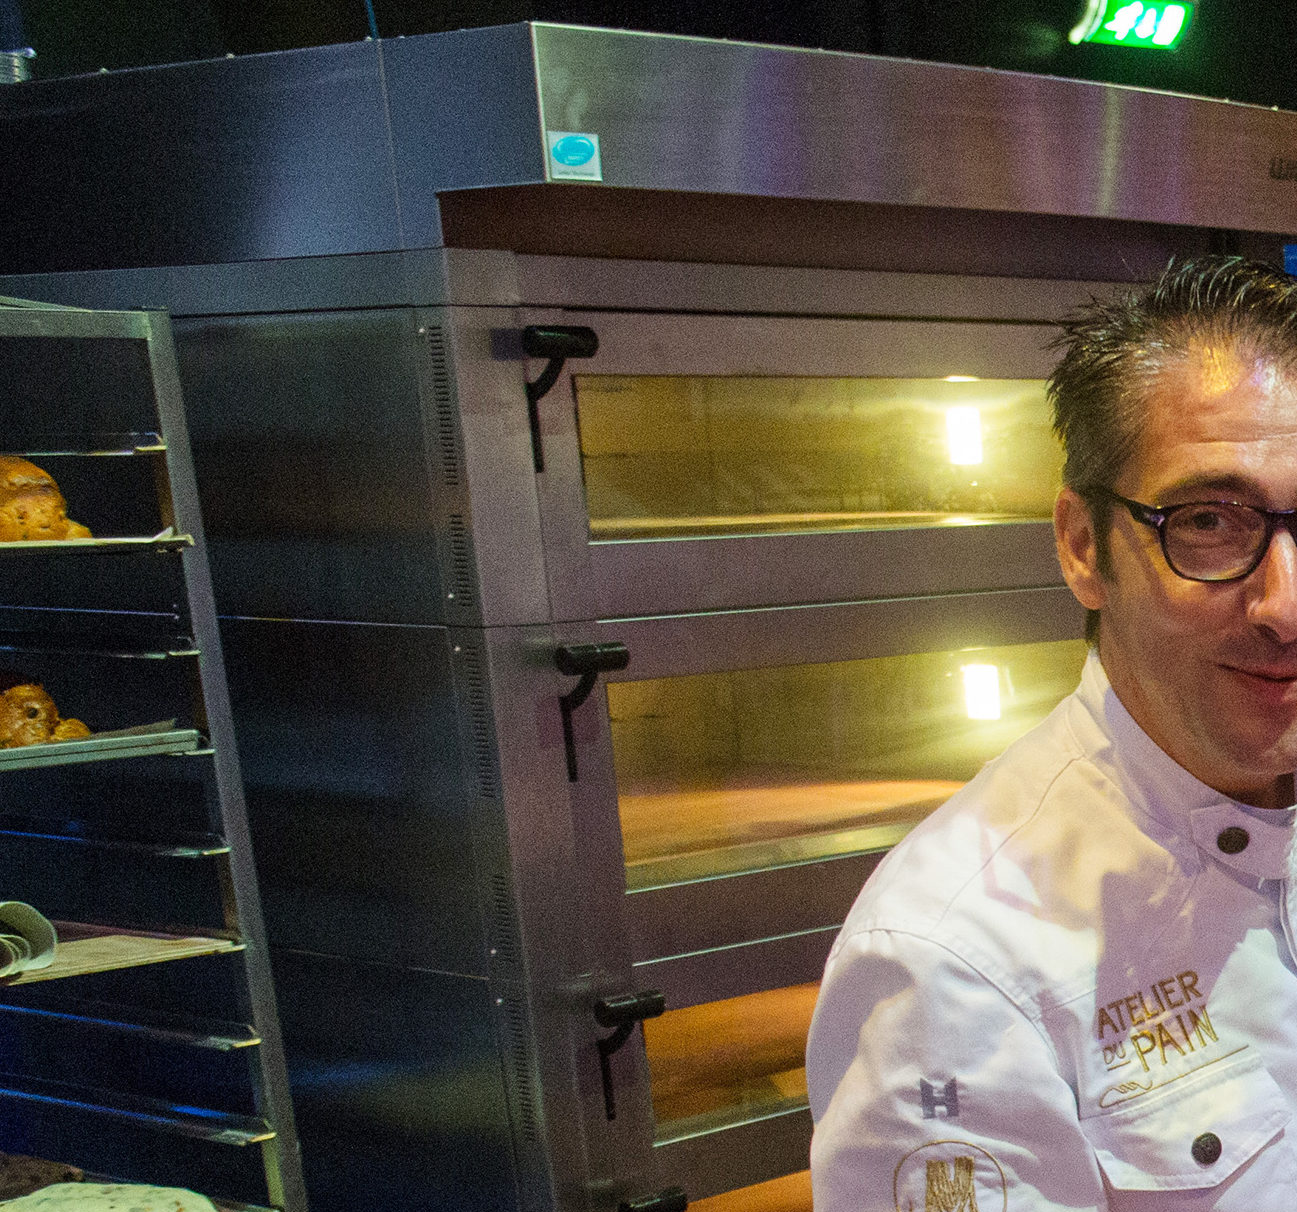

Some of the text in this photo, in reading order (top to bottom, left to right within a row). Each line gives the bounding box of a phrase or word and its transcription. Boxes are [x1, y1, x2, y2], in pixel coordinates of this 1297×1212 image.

[1097, 970, 1204, 1040] ATELIER
[1102, 1004, 1219, 1072] DU PAIN
